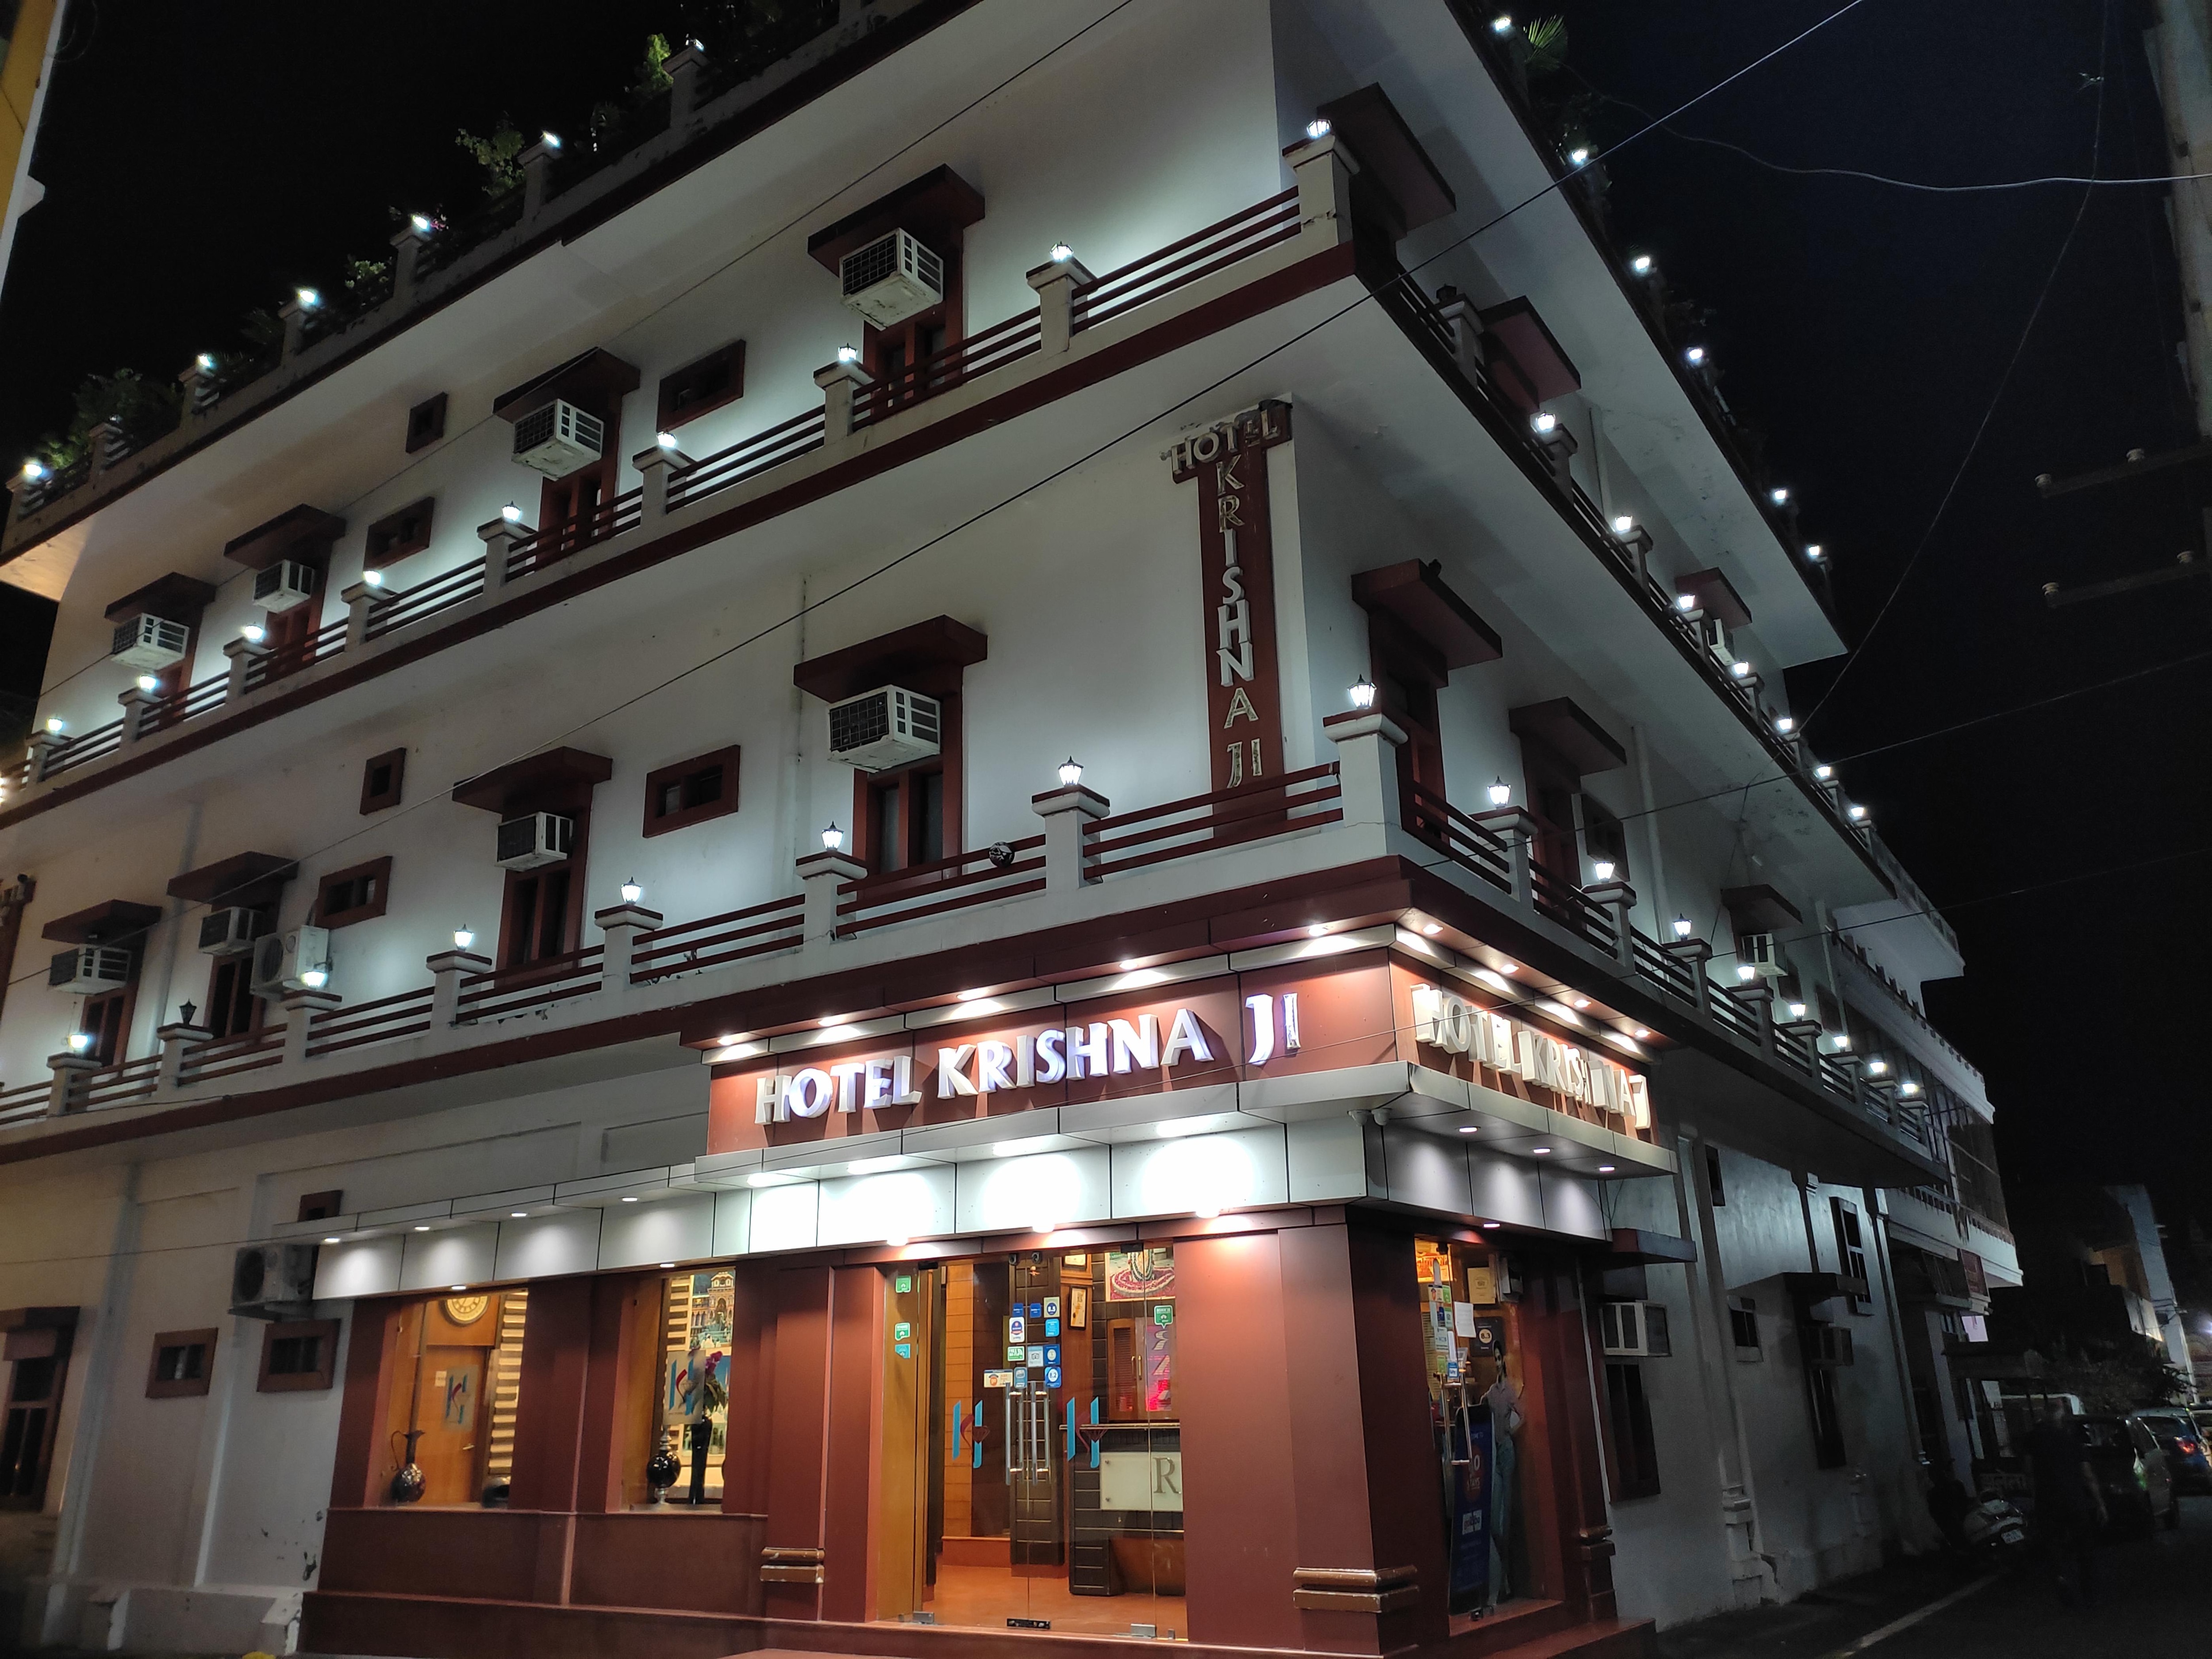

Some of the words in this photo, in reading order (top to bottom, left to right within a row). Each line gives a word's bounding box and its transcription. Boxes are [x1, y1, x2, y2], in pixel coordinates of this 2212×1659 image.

[1171, 409, 1279, 474] HOTEL
[1216, 454, 1259, 729] KRISHNA
[1227, 738, 1263, 789] JI
[754, 1055, 922, 1125] HOTEL
[937, 1009, 1215, 1100] KRISHNA
[1245, 992, 1300, 1065] JI
[1410, 983, 1522, 1075] HOTEL
